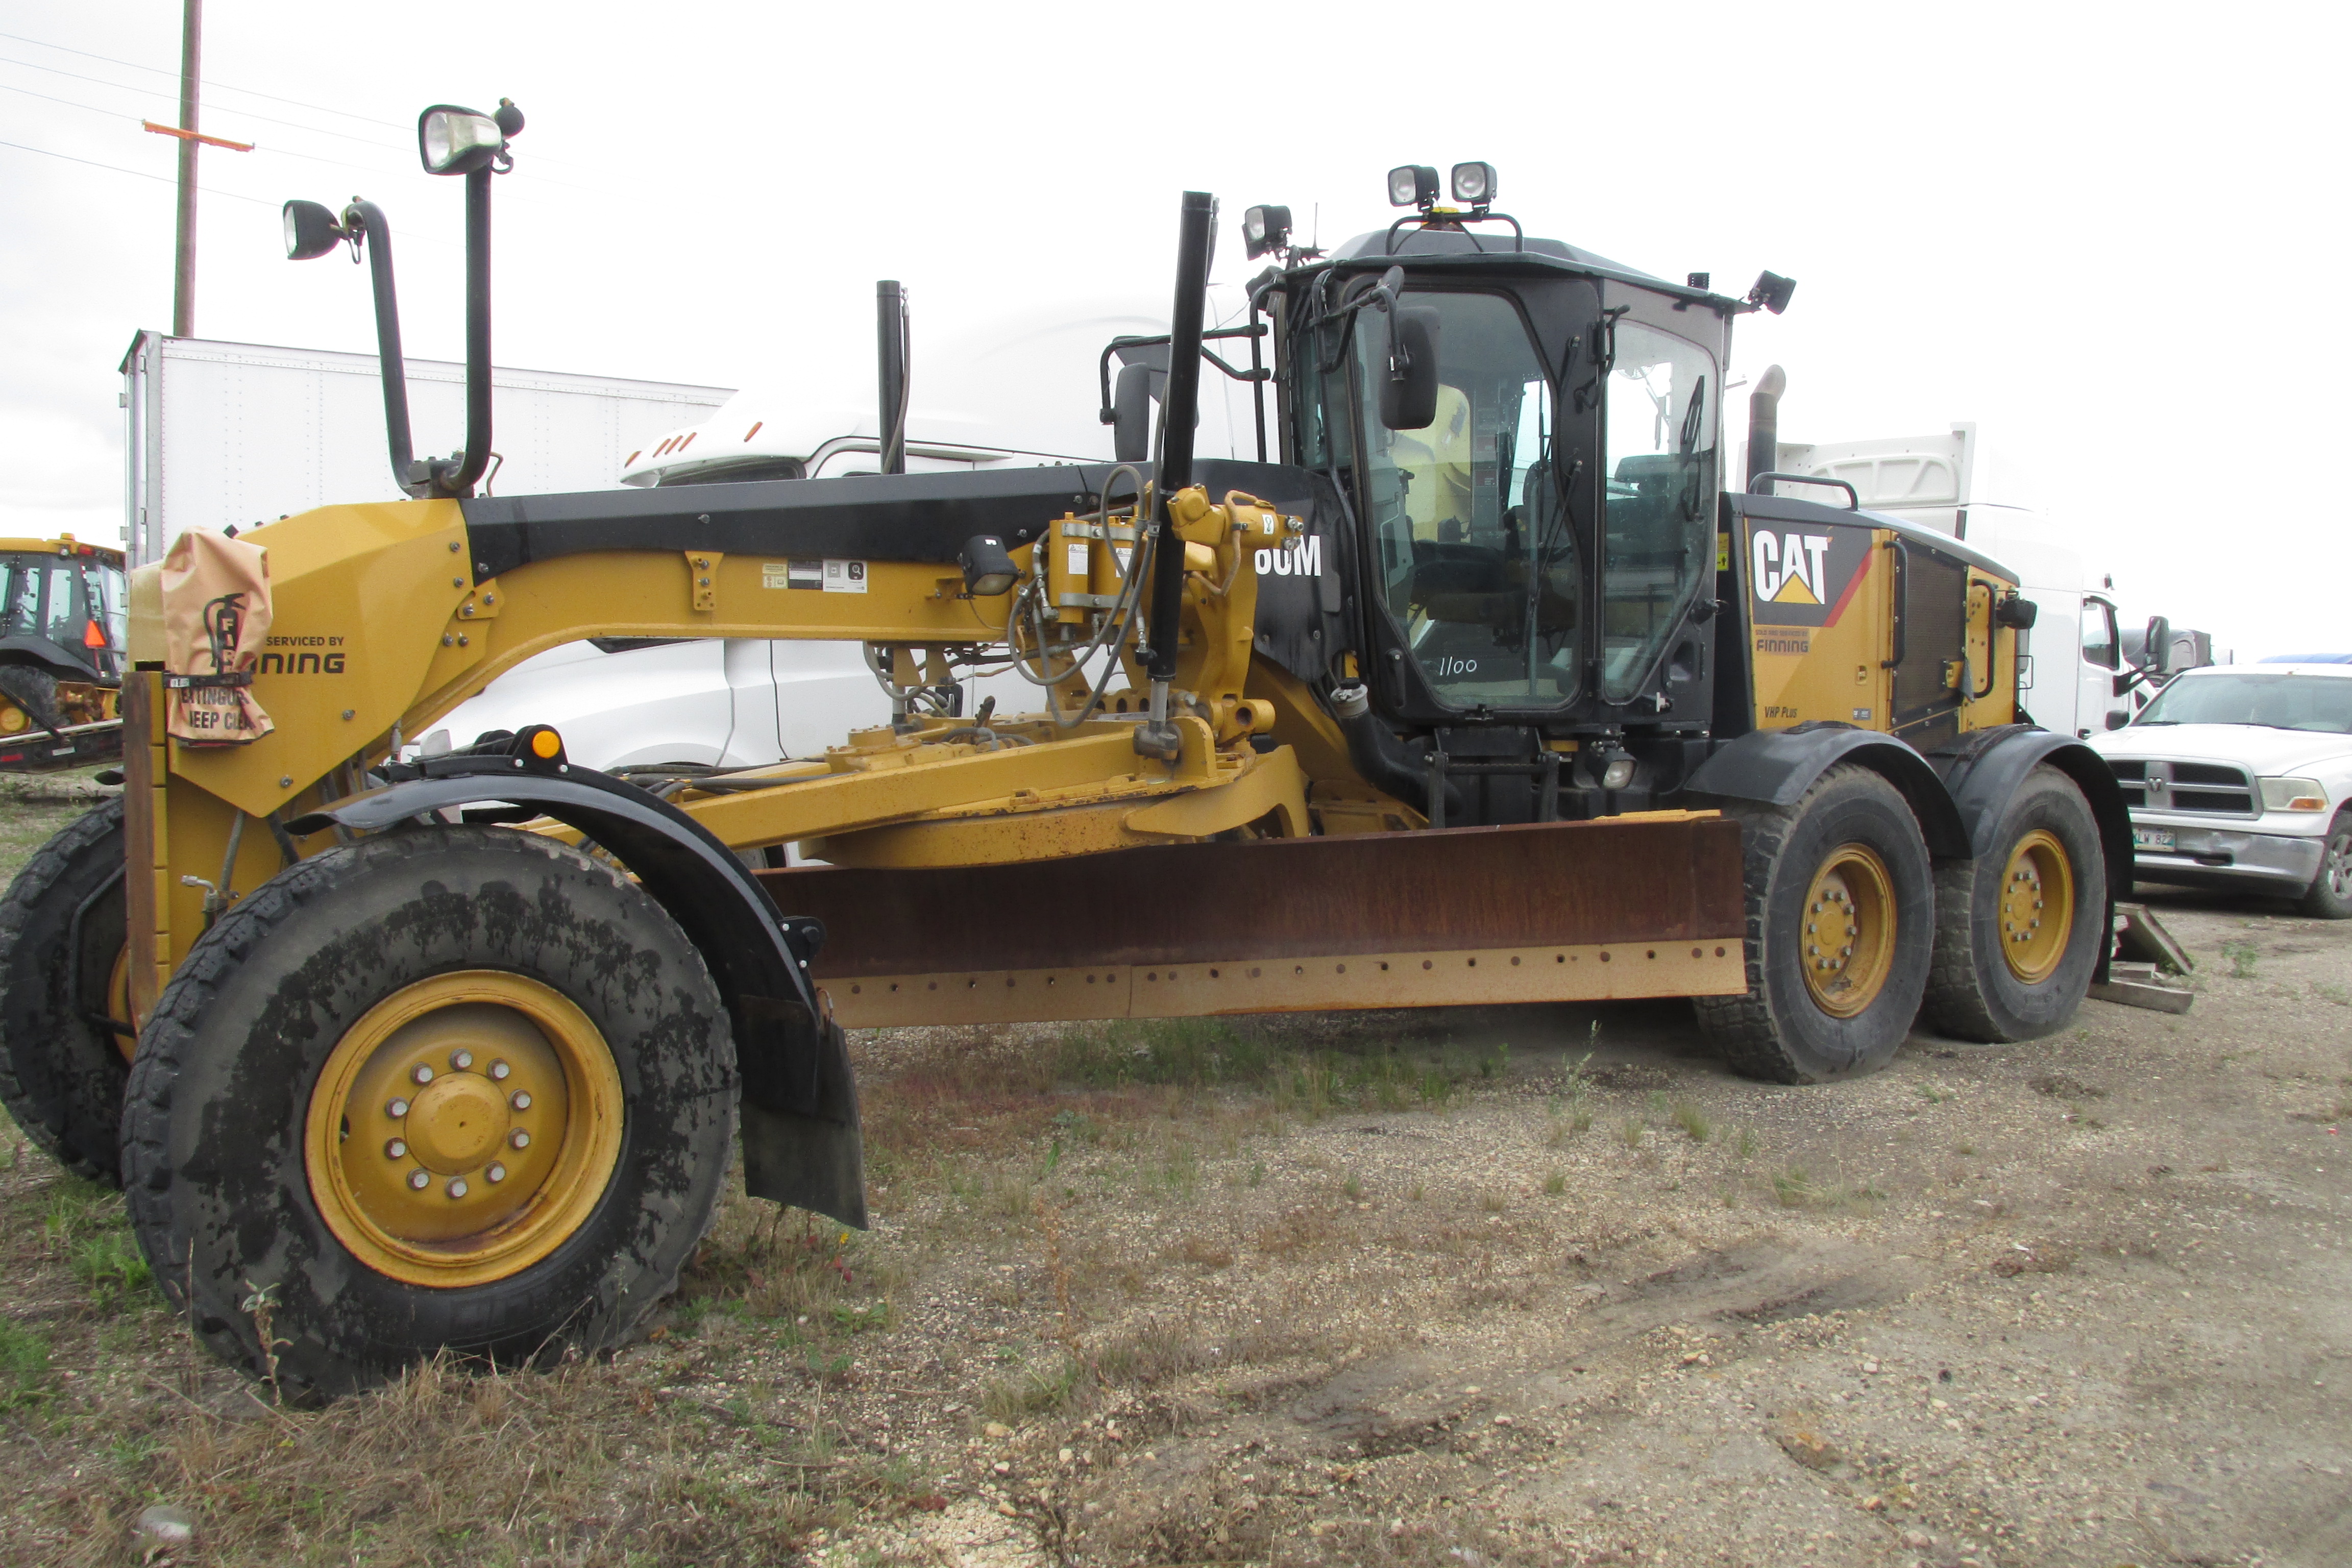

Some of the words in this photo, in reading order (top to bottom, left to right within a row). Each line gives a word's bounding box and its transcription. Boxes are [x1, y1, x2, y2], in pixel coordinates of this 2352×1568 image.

[1753, 530, 1828, 605] CAT
[266, 636, 325, 646] SERVICED
[329, 636, 344, 646] BY
[1756, 639, 1809, 652] FINNING
[1439, 656, 1478, 676] 1100
[1765, 706, 1780, 718] VHP
